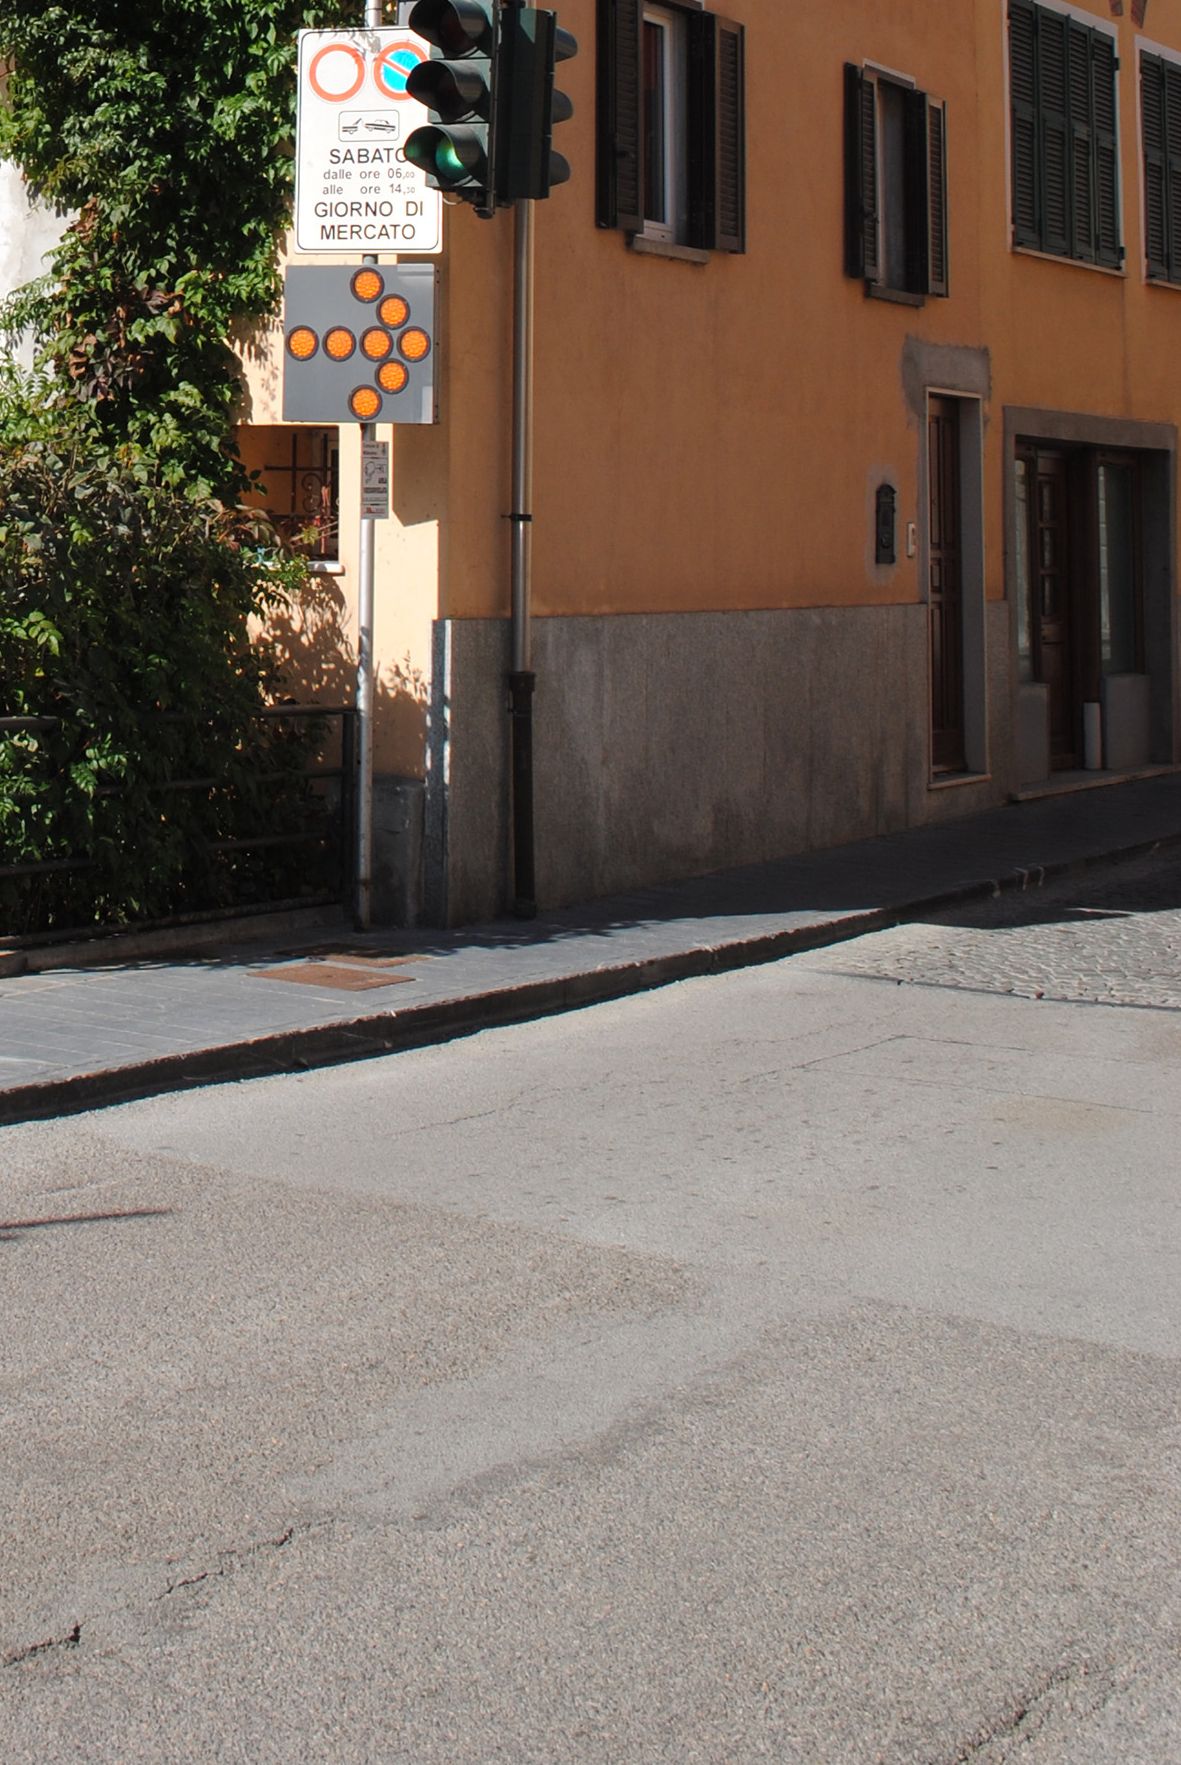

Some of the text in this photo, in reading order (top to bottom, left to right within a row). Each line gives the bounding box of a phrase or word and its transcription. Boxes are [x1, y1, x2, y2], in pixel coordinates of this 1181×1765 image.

[329, 147, 407, 165] SABATO
[323, 169, 352, 180] dalle
[359, 170, 380, 179] ore
[322, 184, 344, 195] alle
[360, 185, 381, 195] ore
[314, 200, 423, 218] GIORNO DI
[320, 223, 416, 240] MERCATO
